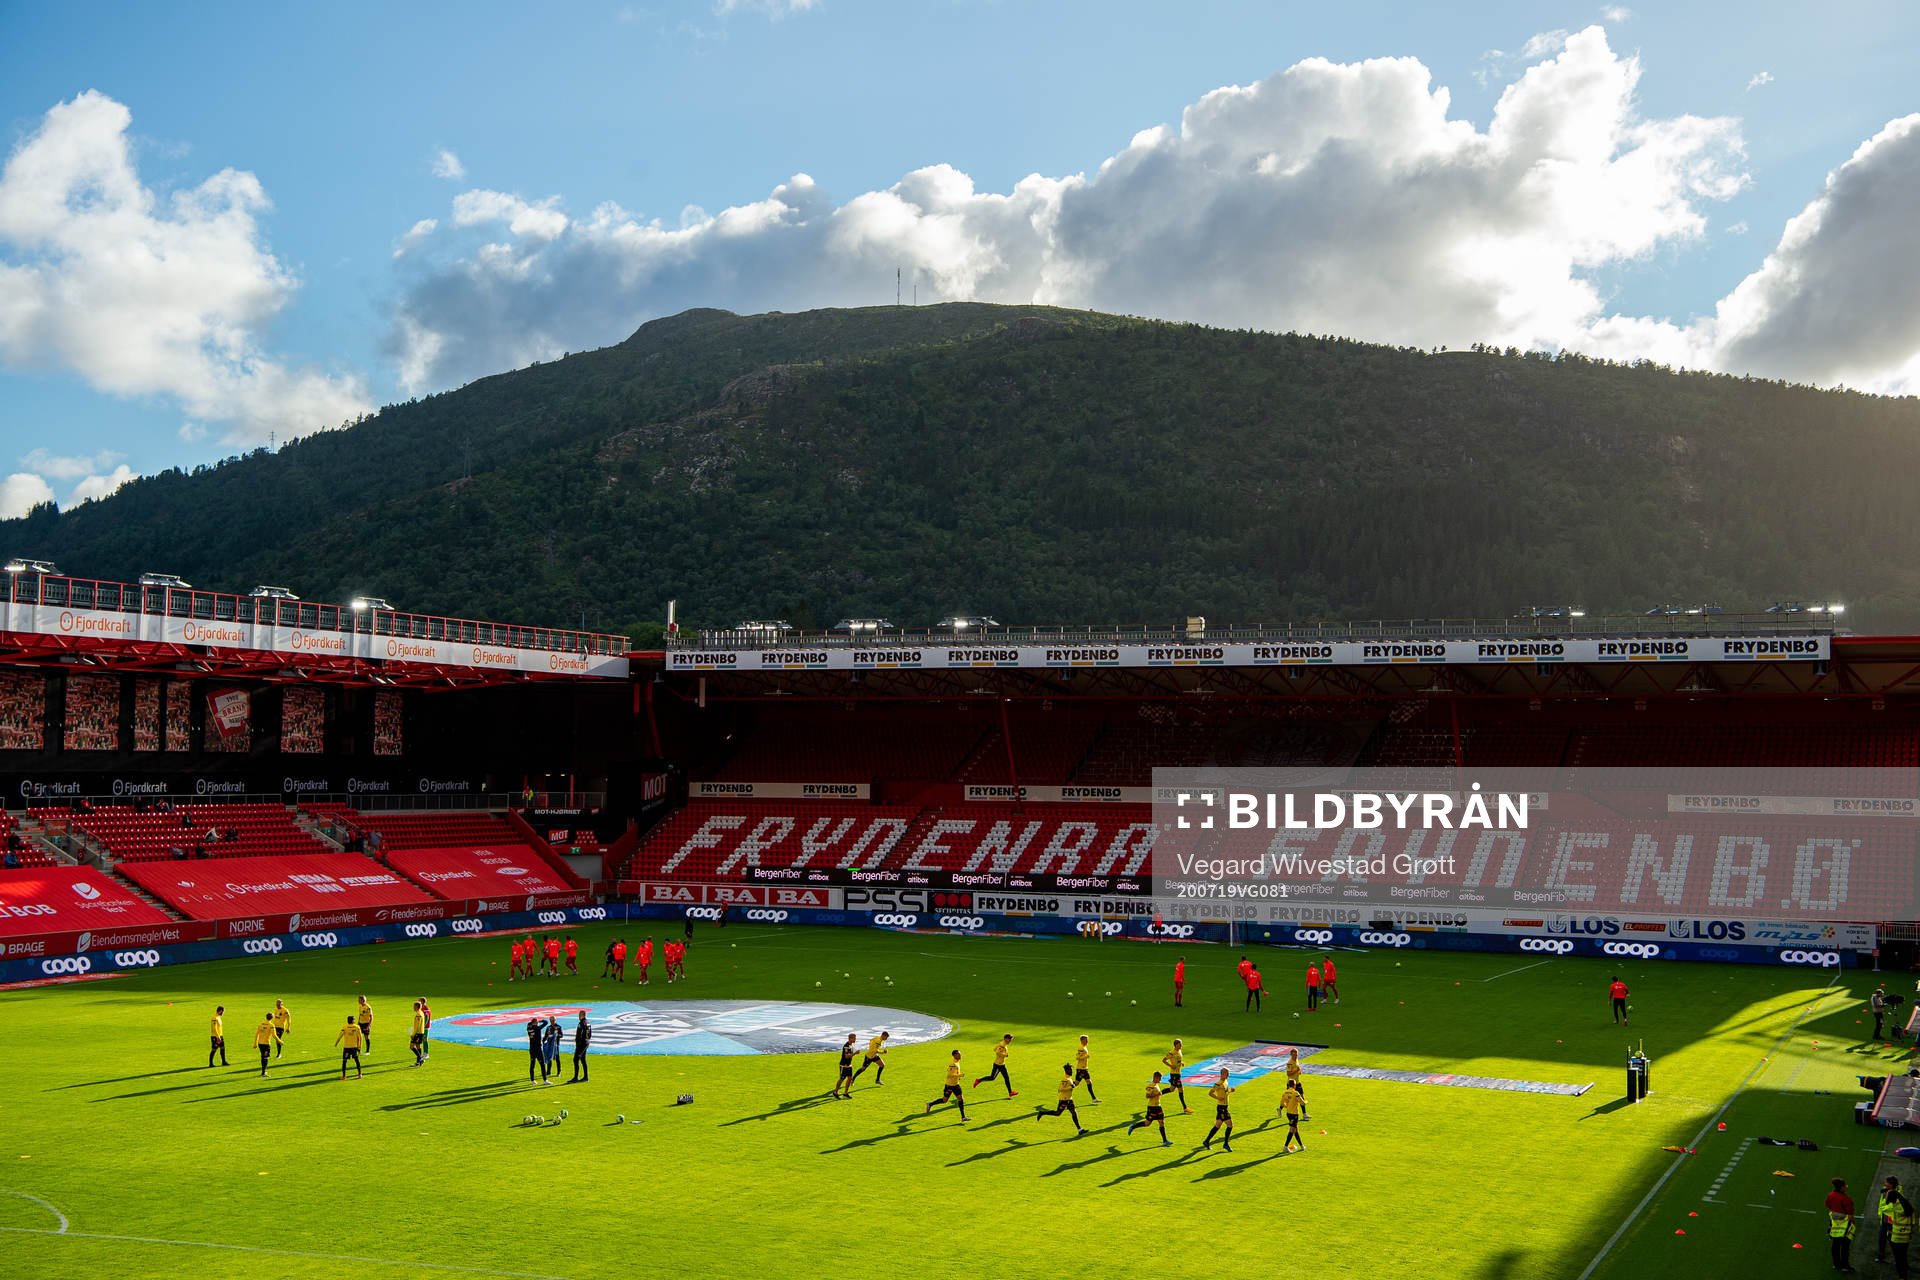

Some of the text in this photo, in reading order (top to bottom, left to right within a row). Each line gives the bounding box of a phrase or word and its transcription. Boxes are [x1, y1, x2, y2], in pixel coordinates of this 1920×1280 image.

[75, 615, 131, 633] Fjordkraft
[197, 626, 245, 642] Fjordkraft
[303, 635, 346, 650] Fjordkraft
[1478, 643, 1564, 656] FRYDENBØ
[1598, 641, 1688, 654] FRYDENBØ
[1724, 639, 1818, 653] FRYDENBØ
[398, 642, 436, 658] Fjordkraft
[854, 652, 921, 662] FRYDENBØ
[949, 650, 1018, 662] FRYDENBØ
[1046, 649, 1119, 661] FRYDENBØ
[1148, 647, 1224, 659] FRYDENBØ
[1254, 646, 1332, 658] FRYDENBØ
[1363, 644, 1446, 656] FRYDENBØ
[482, 651, 516, 665] Fjordkraft
[558, 657, 589, 670] Fjordkraft
[673, 653, 737, 664] FRYDENBØ
[762, 652, 828, 664] FRYDENBØ
[34, 782, 80, 796] Fjdkraft
[125, 782, 167, 793] Fjordkraft
[206, 782, 244, 793] Fjordkraft
[294, 780, 328, 791] Fjordkraft
[644, 773, 668, 800] MOT
[551, 830, 569, 842] MOT
[754, 868, 802, 879] BergenFiber
[851, 870, 900, 882] BergenFiber
[952, 873, 1003, 884] BergenFiber
[1056, 876, 1109, 888] BergenFiber
[653, 886, 694, 900] BA
[714, 888, 758, 903] BA
[777, 890, 820, 904] BA
[1343, 889, 1368, 898] altibox
[1390, 886, 1450, 898] BergenFiber
[1458, 893, 1484, 902] altibox
[488, 902, 510, 912] BRAGE
[844, 890, 924, 912] PSS
[978, 896, 1060, 912] FRYDENBØ
[8, 904, 57, 917] BOB
[391, 906, 444, 920] FrendeForsikring
[538, 911, 566, 924] coop
[579, 906, 606, 920] coop
[746, 908, 788, 922] coop
[1170, 904, 1258, 918] FRYDENBØ
[1270, 906, 1360, 922] FRYDENBØ
[230, 918, 265, 933] NORNE
[301, 912, 358, 927] SparebankenVest
[452, 918, 482, 933] coop
[874, 914, 917, 928] coop
[940, 916, 984, 930] coop
[1570, 916, 1620, 935] LOS
[405, 922, 437, 938] coop
[1694, 920, 1746, 940] LOS
[92, 929, 180, 948] EiendomsmeglerVest
[302, 932, 338, 948] coop
[1360, 932, 1410, 948] coop
[9, 941, 45, 954] BRAGE
[244, 938, 282, 954] coop
[1520, 938, 1574, 954] coop
[1604, 942, 1660, 958] coop
[42, 956, 91, 974] coop
[115, 950, 160, 966] coop
[1780, 950, 1840, 968] coop
